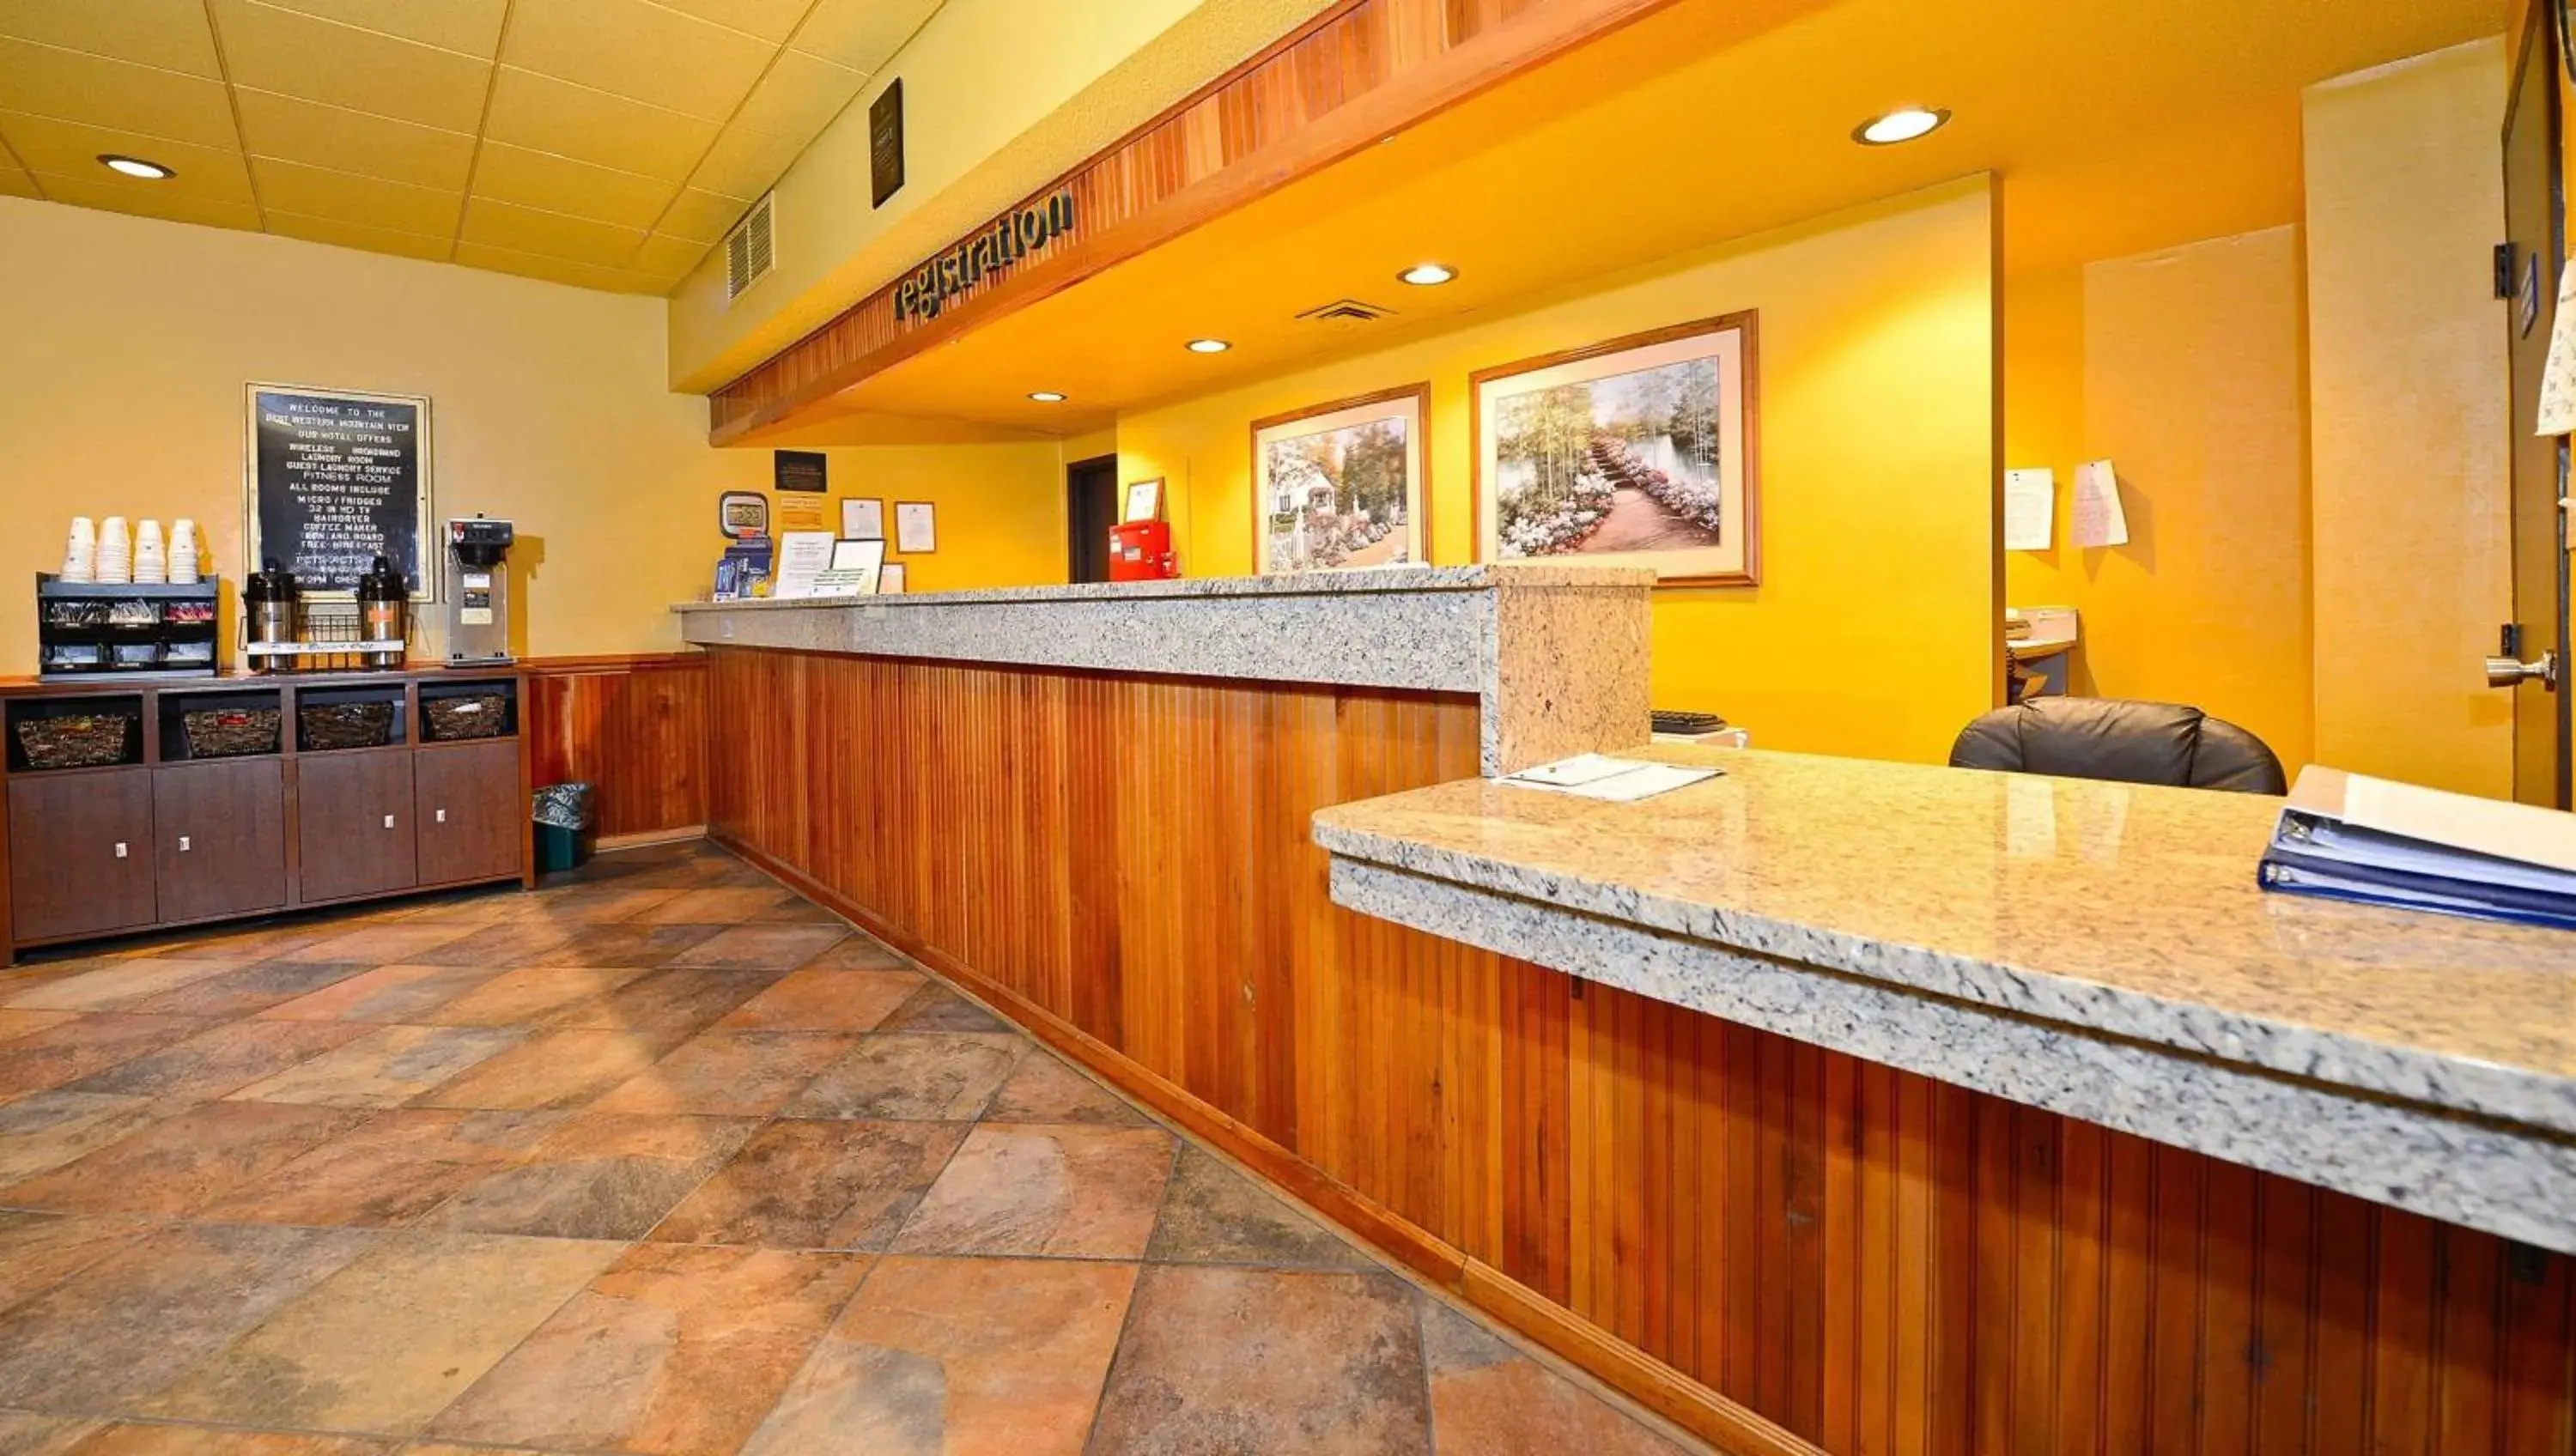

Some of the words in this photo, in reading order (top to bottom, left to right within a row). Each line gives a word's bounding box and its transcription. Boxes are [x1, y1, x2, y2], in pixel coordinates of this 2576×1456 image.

[894, 191, 1073, 320] registration
[289, 404, 339, 416] WELCOME
[339, 420, 385, 431] MOUNTAIN
[298, 430, 318, 439] OUR
[356, 434, 392, 444] OFFERS
[289, 444, 336, 453] WIRELESS
[301, 453, 343, 463] LAUNDRY
[286, 462, 318, 470] GUEST
[320, 464, 361, 473] LAUNDRY
[303, 471, 350, 482] FITNESS
[355, 473, 392, 483] ROOM
[289, 483, 308, 492] ALL
[311, 483, 346, 493] ROOMS
[349, 486, 392, 495] INCLUDE
[309, 504, 324, 513] 32
[340, 506, 355, 514] HD
[303, 523, 342, 531] COFFEE
[344, 524, 378, 532] MAKER
[353, 533, 385, 542] BOARD
